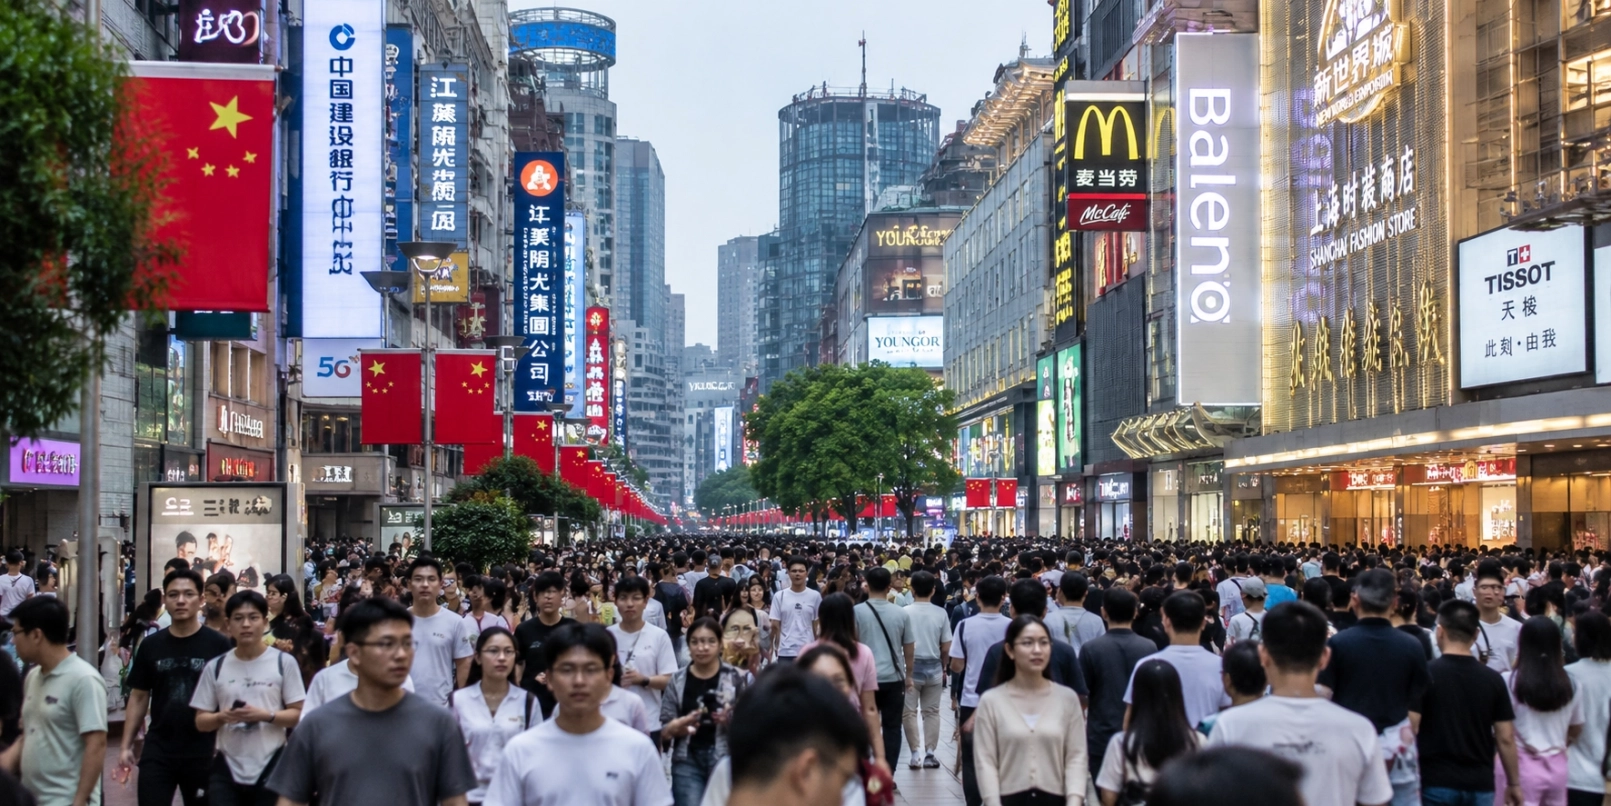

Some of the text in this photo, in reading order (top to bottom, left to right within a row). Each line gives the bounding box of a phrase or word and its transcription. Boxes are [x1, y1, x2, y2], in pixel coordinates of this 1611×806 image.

[1350, 220, 1385, 253] FASHION
[1387, 207, 1416, 237] STORE
[1484, 260, 1555, 294] TISSOT
[875, 336, 940, 348] YOUNGOR
